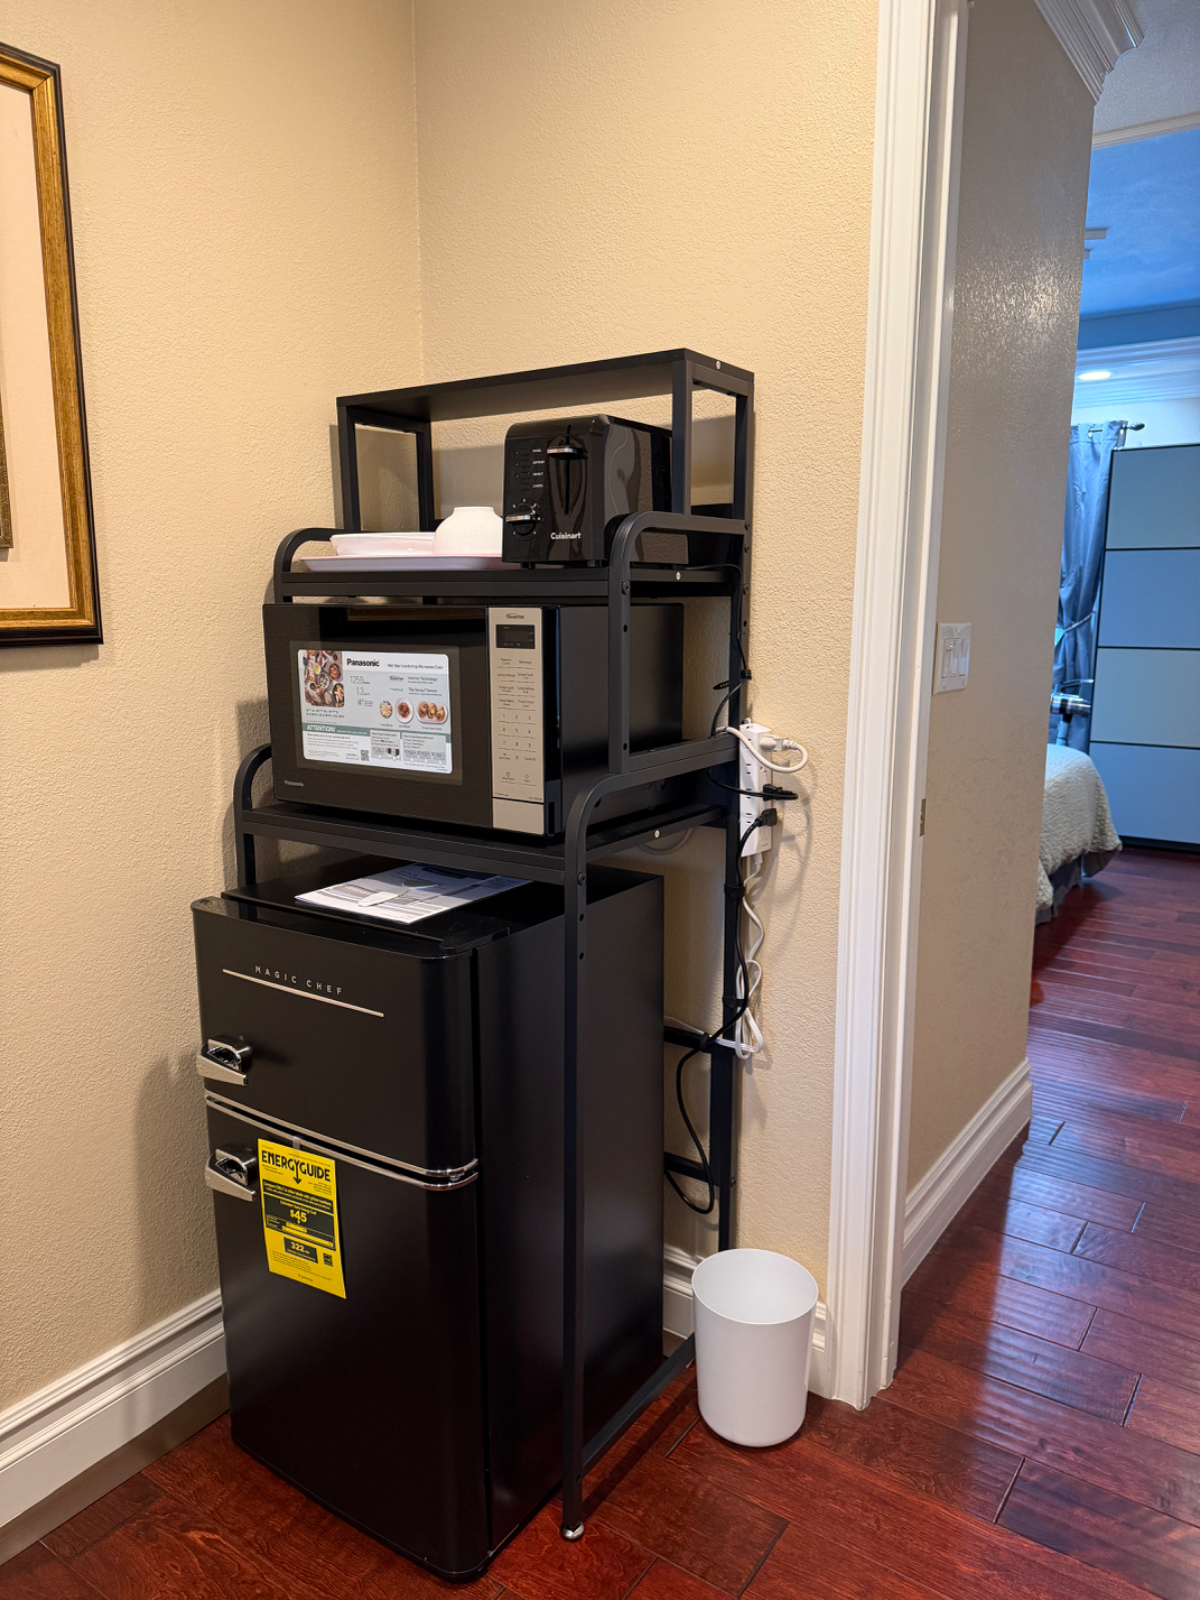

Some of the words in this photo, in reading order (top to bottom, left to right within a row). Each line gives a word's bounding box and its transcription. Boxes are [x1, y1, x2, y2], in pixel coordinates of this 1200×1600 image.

[550, 532, 582, 540] Cuisinart
[346, 658, 380, 667] Panasonic
[255, 965, 297, 984] MAGIC
[306, 980, 342, 995] CHEF
[261, 1150, 331, 1183] ENERGYGUIDE
[290, 1209, 307, 1223] $45
